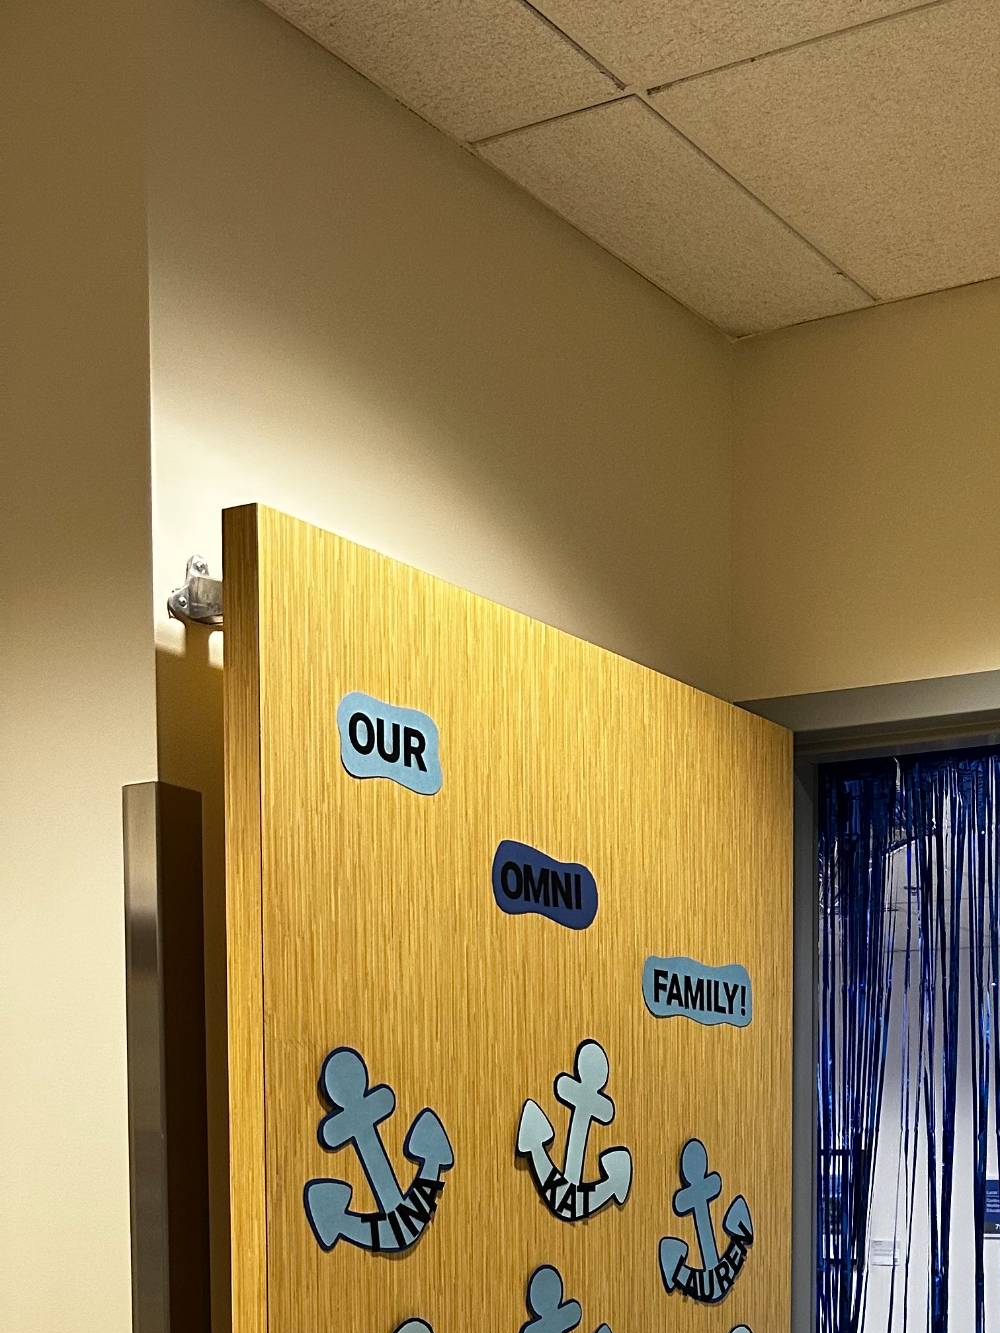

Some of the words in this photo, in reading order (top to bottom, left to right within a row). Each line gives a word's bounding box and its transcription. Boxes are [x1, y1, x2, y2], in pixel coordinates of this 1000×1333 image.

[348, 711, 428, 773] OUR
[500, 861, 583, 911] OMNI
[653, 968, 747, 1017] FAMILY!
[360, 1178, 446, 1252] TINA
[542, 1168, 596, 1221] KAT
[672, 1220, 752, 1302] LAUREN
